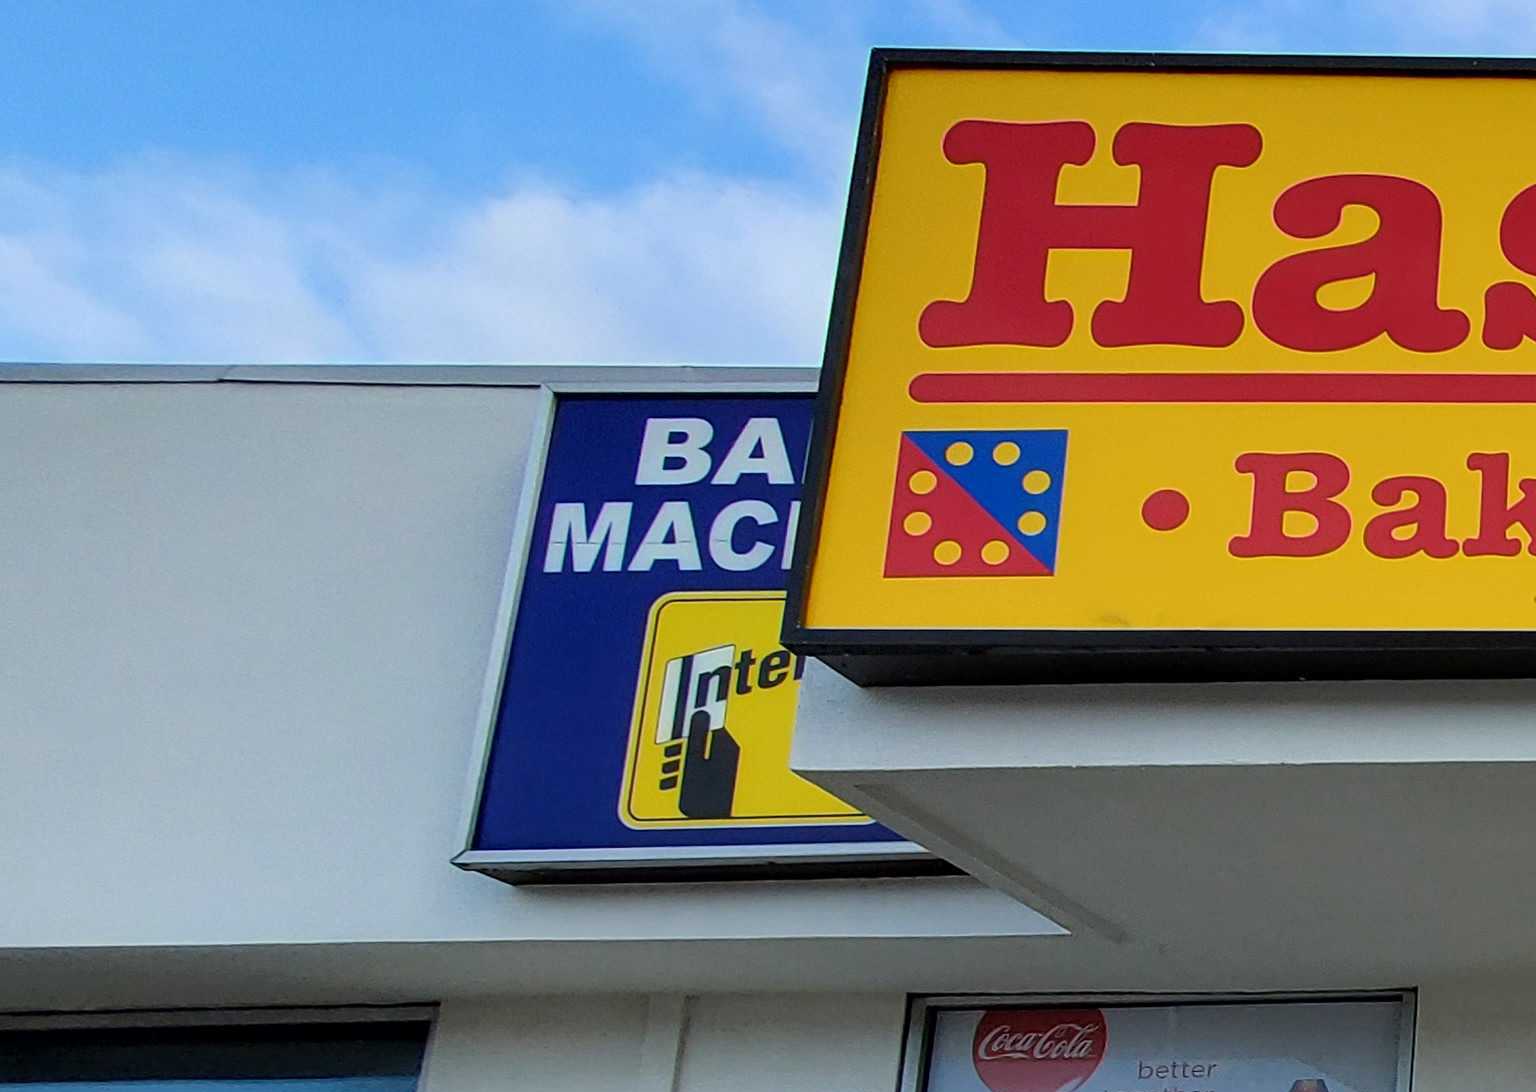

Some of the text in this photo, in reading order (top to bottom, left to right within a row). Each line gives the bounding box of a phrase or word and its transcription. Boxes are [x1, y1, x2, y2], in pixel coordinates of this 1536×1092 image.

[634, 416, 805, 486] BA
[978, 1022, 1097, 1062] Coca-Cola
[1137, 1060, 1218, 1081] better
